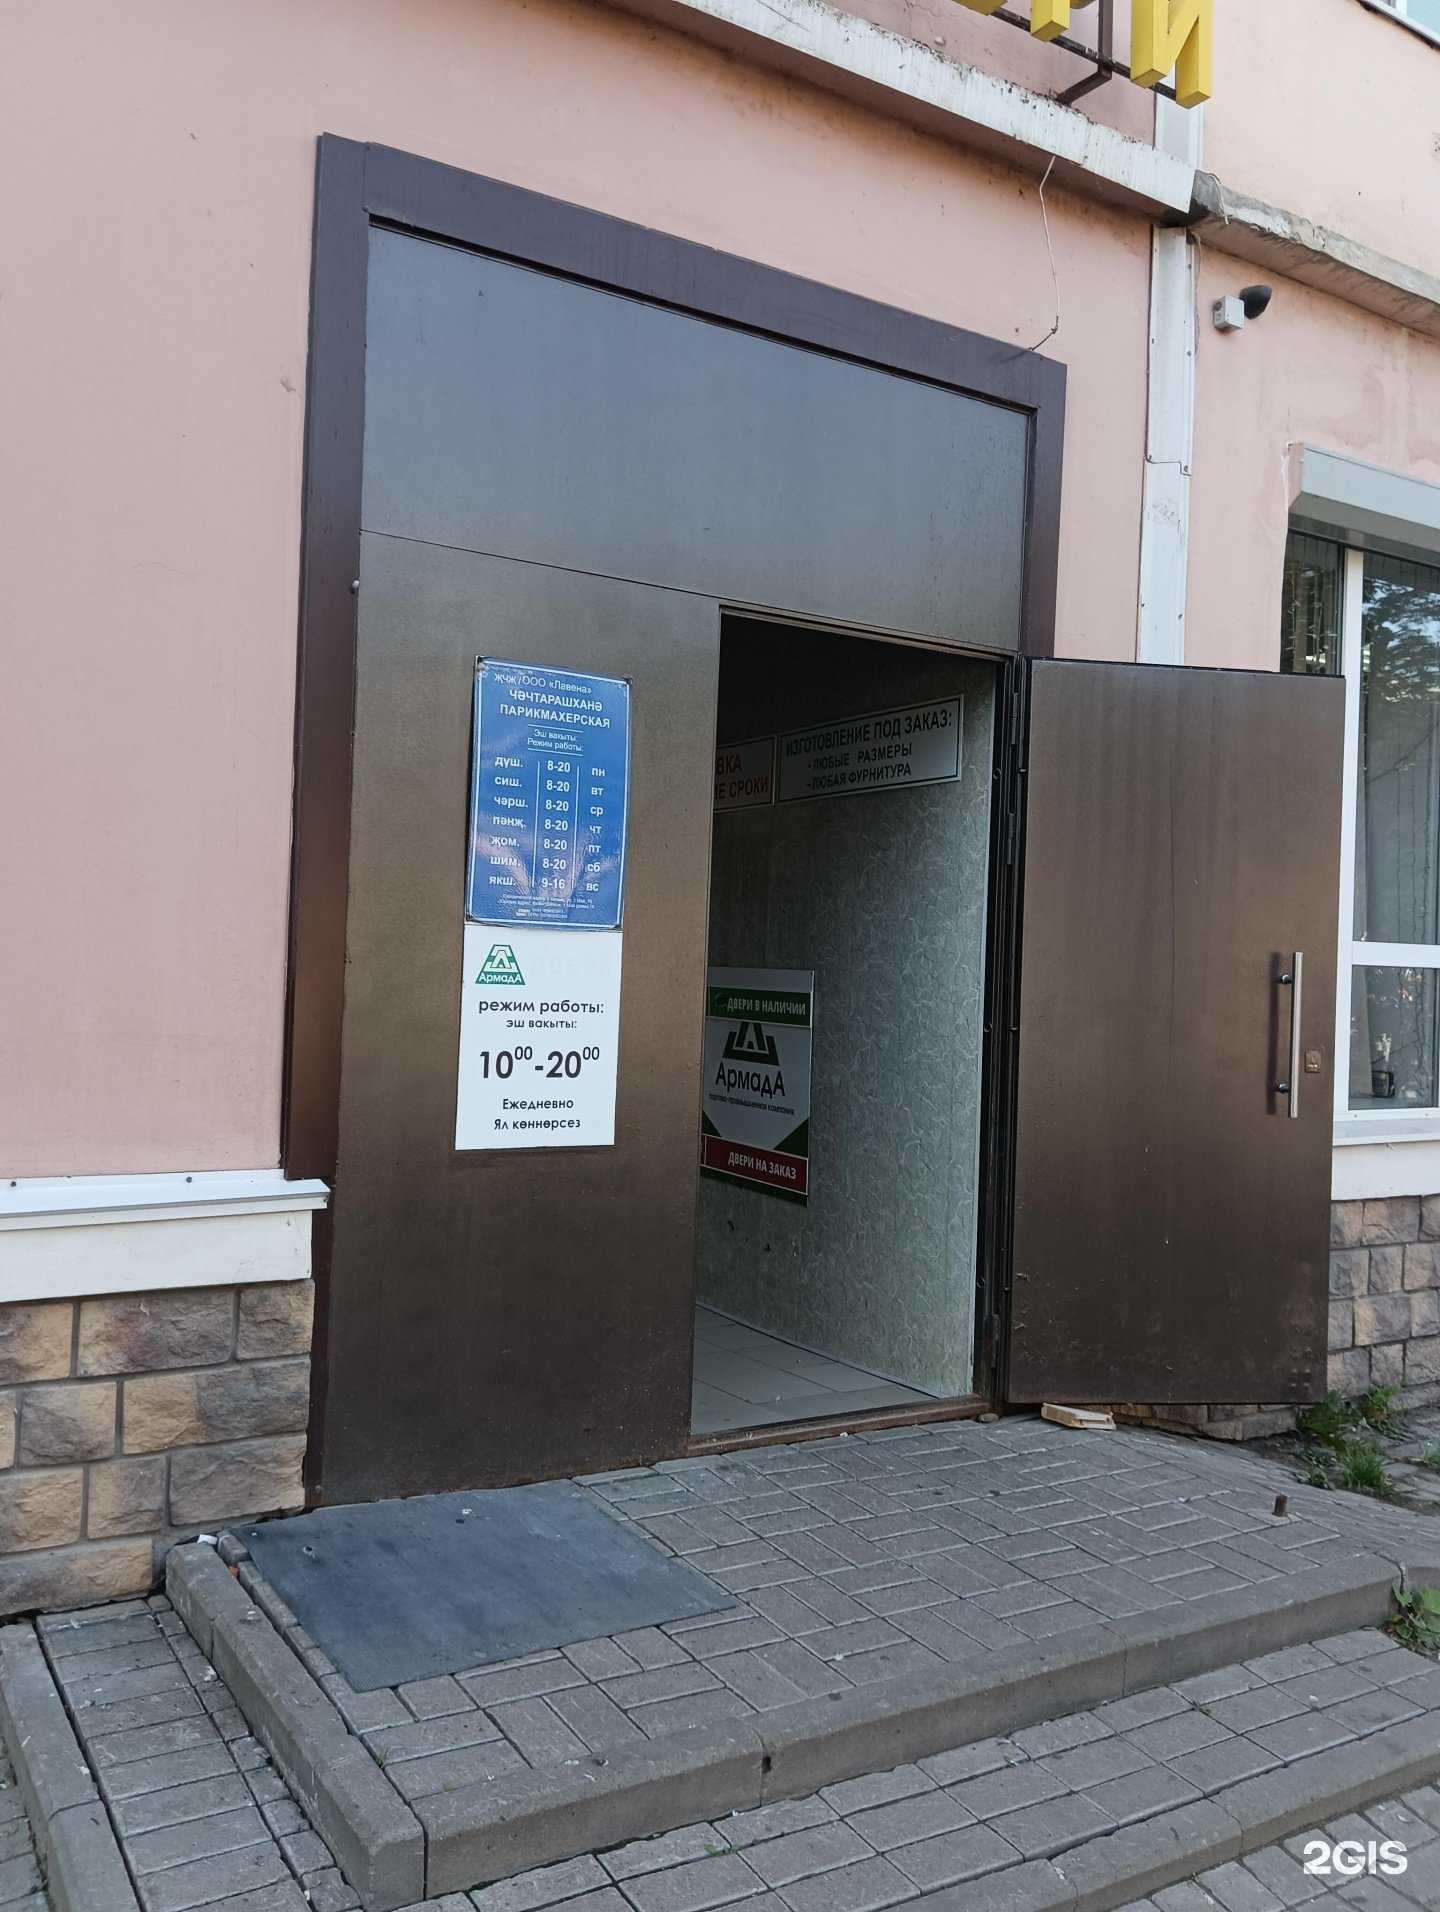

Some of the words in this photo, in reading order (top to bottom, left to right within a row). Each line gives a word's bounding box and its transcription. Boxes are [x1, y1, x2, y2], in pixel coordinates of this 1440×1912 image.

[509, 689, 603, 711] ЧӘЧТАРАШХАНӘ
[500, 703, 611, 728] ПАРИКМАХЕРСКАЯ
[527, 737, 553, 748] Режим
[785, 723, 871, 757] ИЗГОТОВЛЕНИЕ
[873, 717, 901, 739] ПОД
[904, 709, 952, 735] ЗАКАЗ:
[857, 743, 912, 764] РАЗМЕРЫ
[547, 760, 571, 773] 8-20
[591, 768, 605, 777] пн
[716, 753, 743, 776] ВКА
[849, 763, 911, 784] ФУРНИТУРА
[494, 776, 522, 787] сиш.
[546, 779, 570, 792] 8-20
[591, 787, 604, 796] вт
[729, 776, 769, 798] СРОКИ
[494, 796, 528, 809] чәрш.
[545, 799, 569, 812] 8-20
[590, 806, 604, 817] ср
[544, 819, 568, 831] 8-20
[589, 826, 602, 835] чт
[543, 838, 567, 850] 8-20
[588, 845, 601, 853] пт
[490, 856, 520, 867] шим.
[542, 858, 566, 870] 8-20
[587, 861, 601, 873] сб
[488, 876, 516, 887] якш.
[541, 877, 565, 889] 9-16
[586, 883, 599, 892] вс
[478, 972, 523, 984] АрмадА
[479, 1000, 535, 1014] режим
[540, 1000, 604, 1014] работы:
[727, 997, 753, 1012] ДВЕРИ
[755, 1000, 760, 1011] В
[762, 1001, 806, 1016] НАЛИЧИИ
[506, 1019, 525, 1028] эш
[528, 1019, 577, 1029] вакыты:
[715, 1062, 786, 1099] АрмадА
[502, 1098, 574, 1111] Ежедневно
[494, 1118, 509, 1130] Ял
[728, 1151, 755, 1169] ДВЕРИ
[756, 1159, 767, 1172] НА
[767, 1161, 797, 1180] ЗАКАЗ
